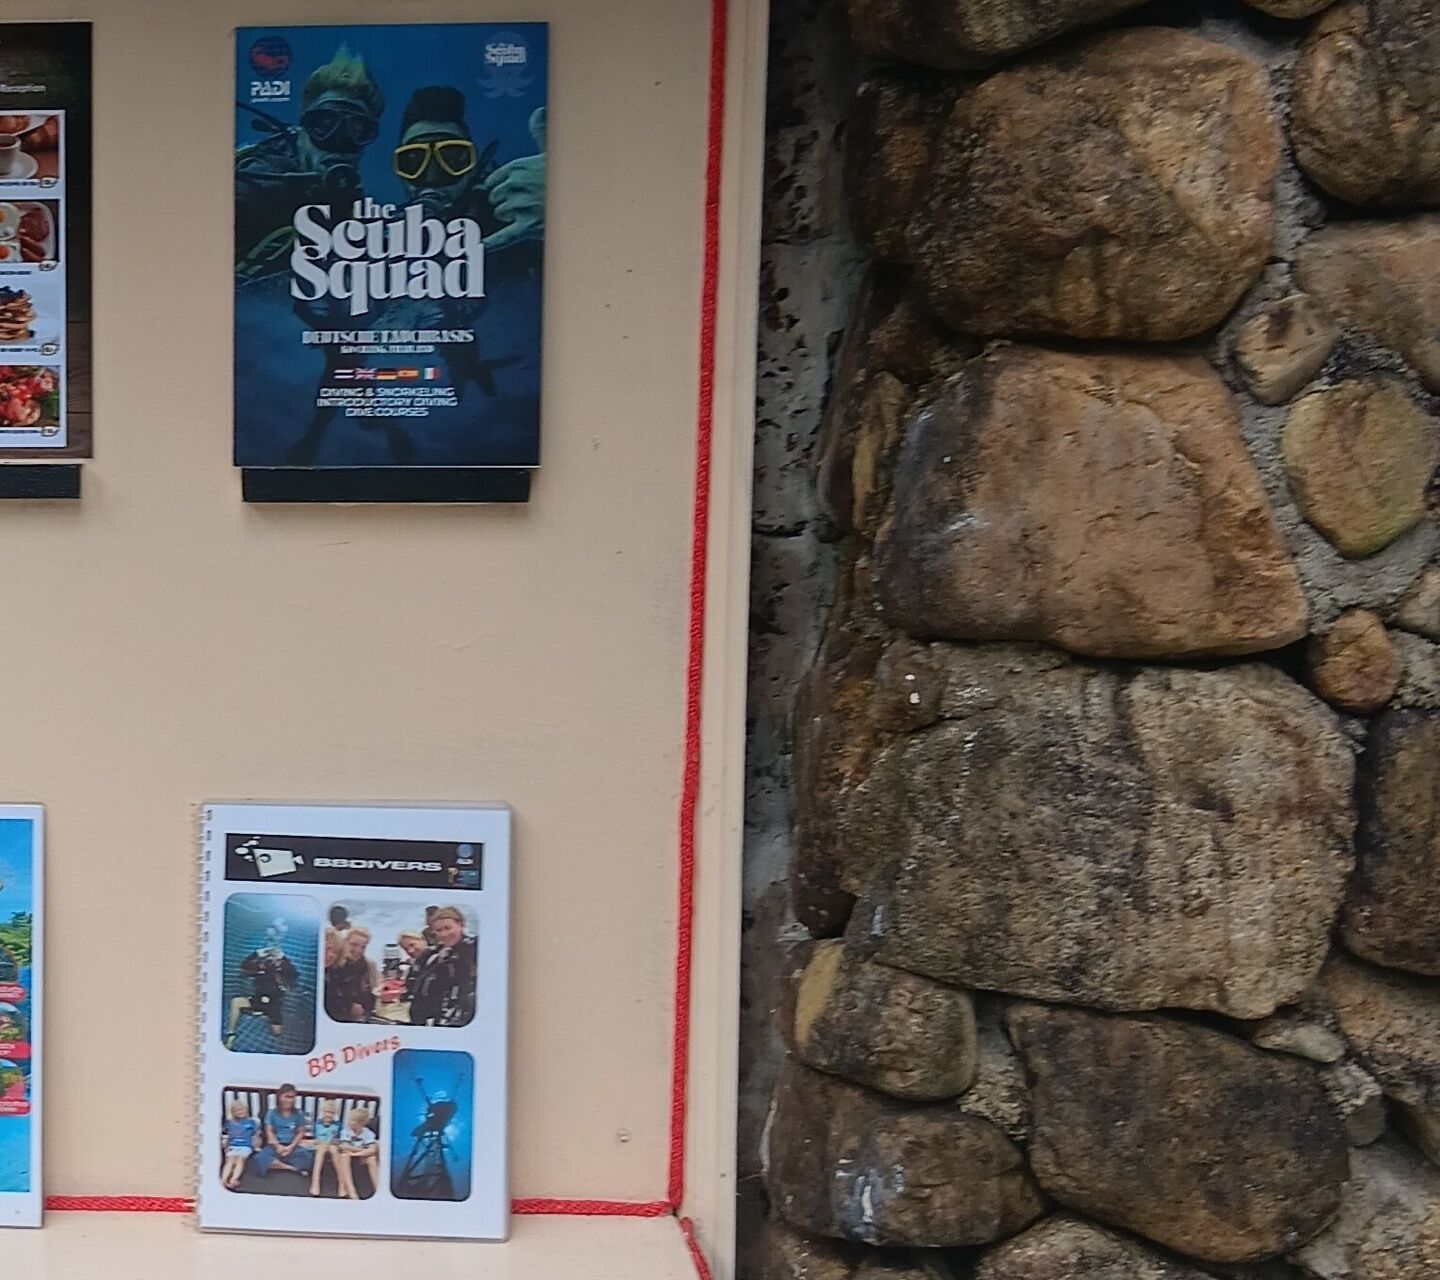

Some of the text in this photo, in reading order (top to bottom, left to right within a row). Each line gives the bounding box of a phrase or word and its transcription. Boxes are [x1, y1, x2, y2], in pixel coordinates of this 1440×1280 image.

[250, 81, 291, 96] PADI
[353, 197, 398, 219] the
[293, 204, 485, 259] Scuba
[290, 243, 486, 316] Squad
[320, 388, 363, 397] DIVING
[412, 397, 458, 406] DIVING
